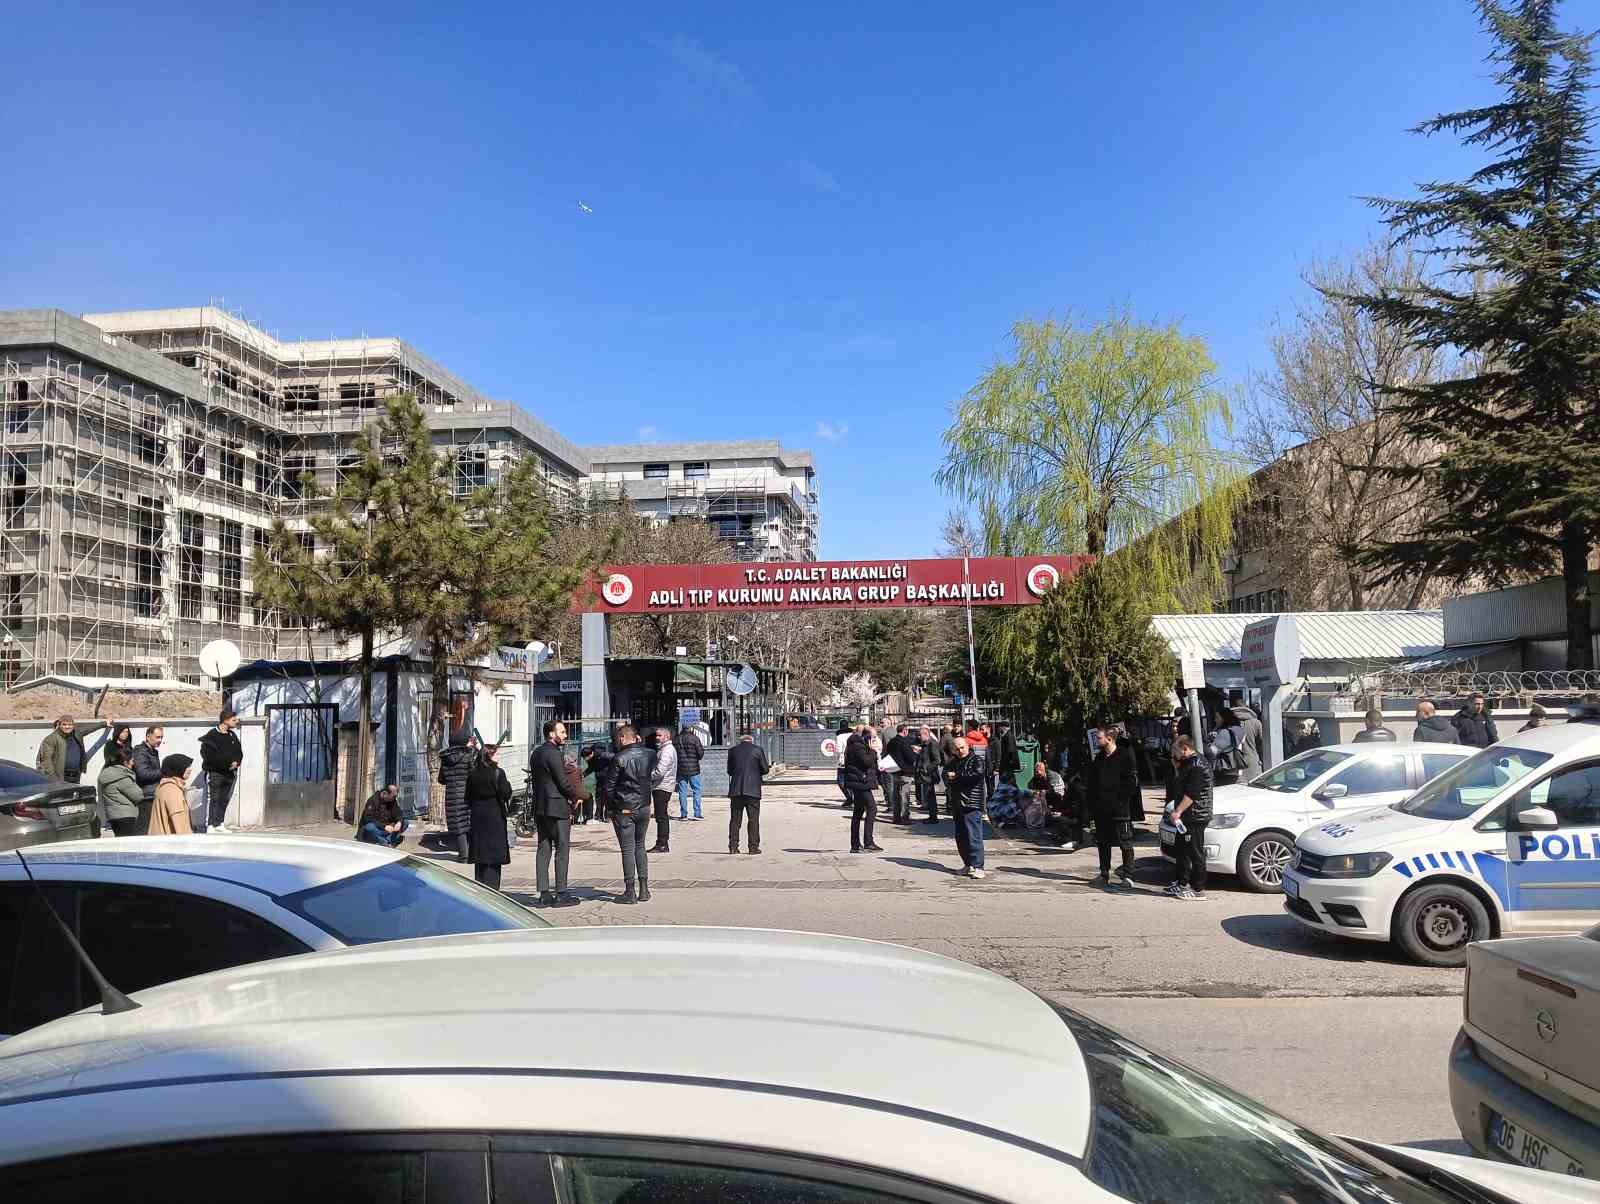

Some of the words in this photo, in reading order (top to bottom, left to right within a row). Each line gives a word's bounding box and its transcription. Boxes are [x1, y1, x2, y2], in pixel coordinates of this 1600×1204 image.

[746, 568, 771, 583] T.C.
[775, 567, 827, 582] ADALET
[831, 563, 907, 581] BAKANLIĞI
[649, 587, 684, 605] ADLİ
[689, 589, 713, 604] TIP
[717, 588, 784, 603] KURUMU
[789, 586, 853, 602] ANKARA
[857, 585, 900, 600] GRUP
[906, 580, 1005, 601] BAŞKANLIĞI
[1518, 833, 1600, 861] POLİ
[1499, 1119, 1516, 1151] 06
